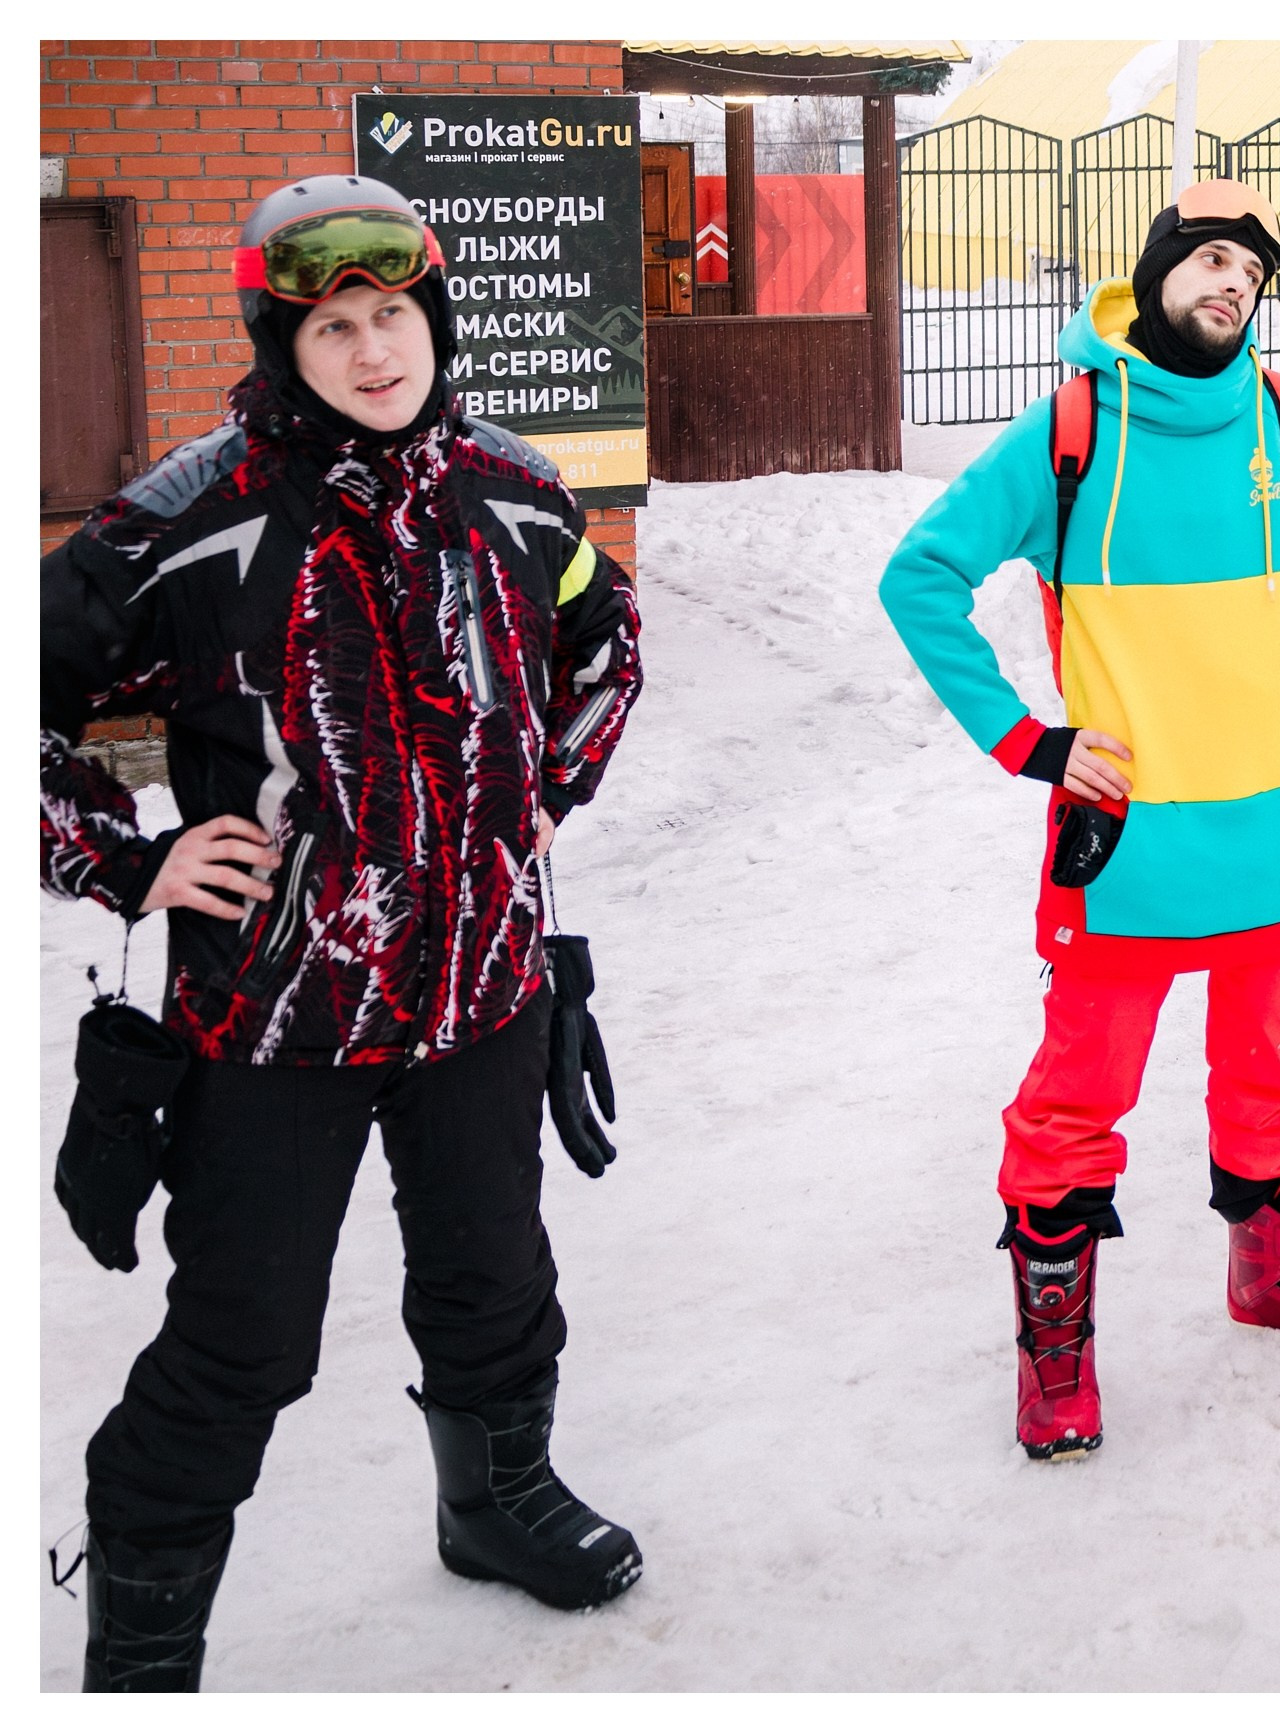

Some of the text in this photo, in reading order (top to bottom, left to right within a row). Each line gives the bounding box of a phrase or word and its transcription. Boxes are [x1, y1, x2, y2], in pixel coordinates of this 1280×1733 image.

[424, 117, 632, 148] ProkatGu.ru
[425, 154, 565, 164] магазин прокат сервис
[455, 235, 560, 262] ЛЫЖИ
[445, 272, 591, 301] ОСТЮМЫ
[456, 311, 565, 339] МАСКИ
[446, 347, 612, 379] И-СЕРВИС
[1042, 1260, 1075, 1274] RAIDER
